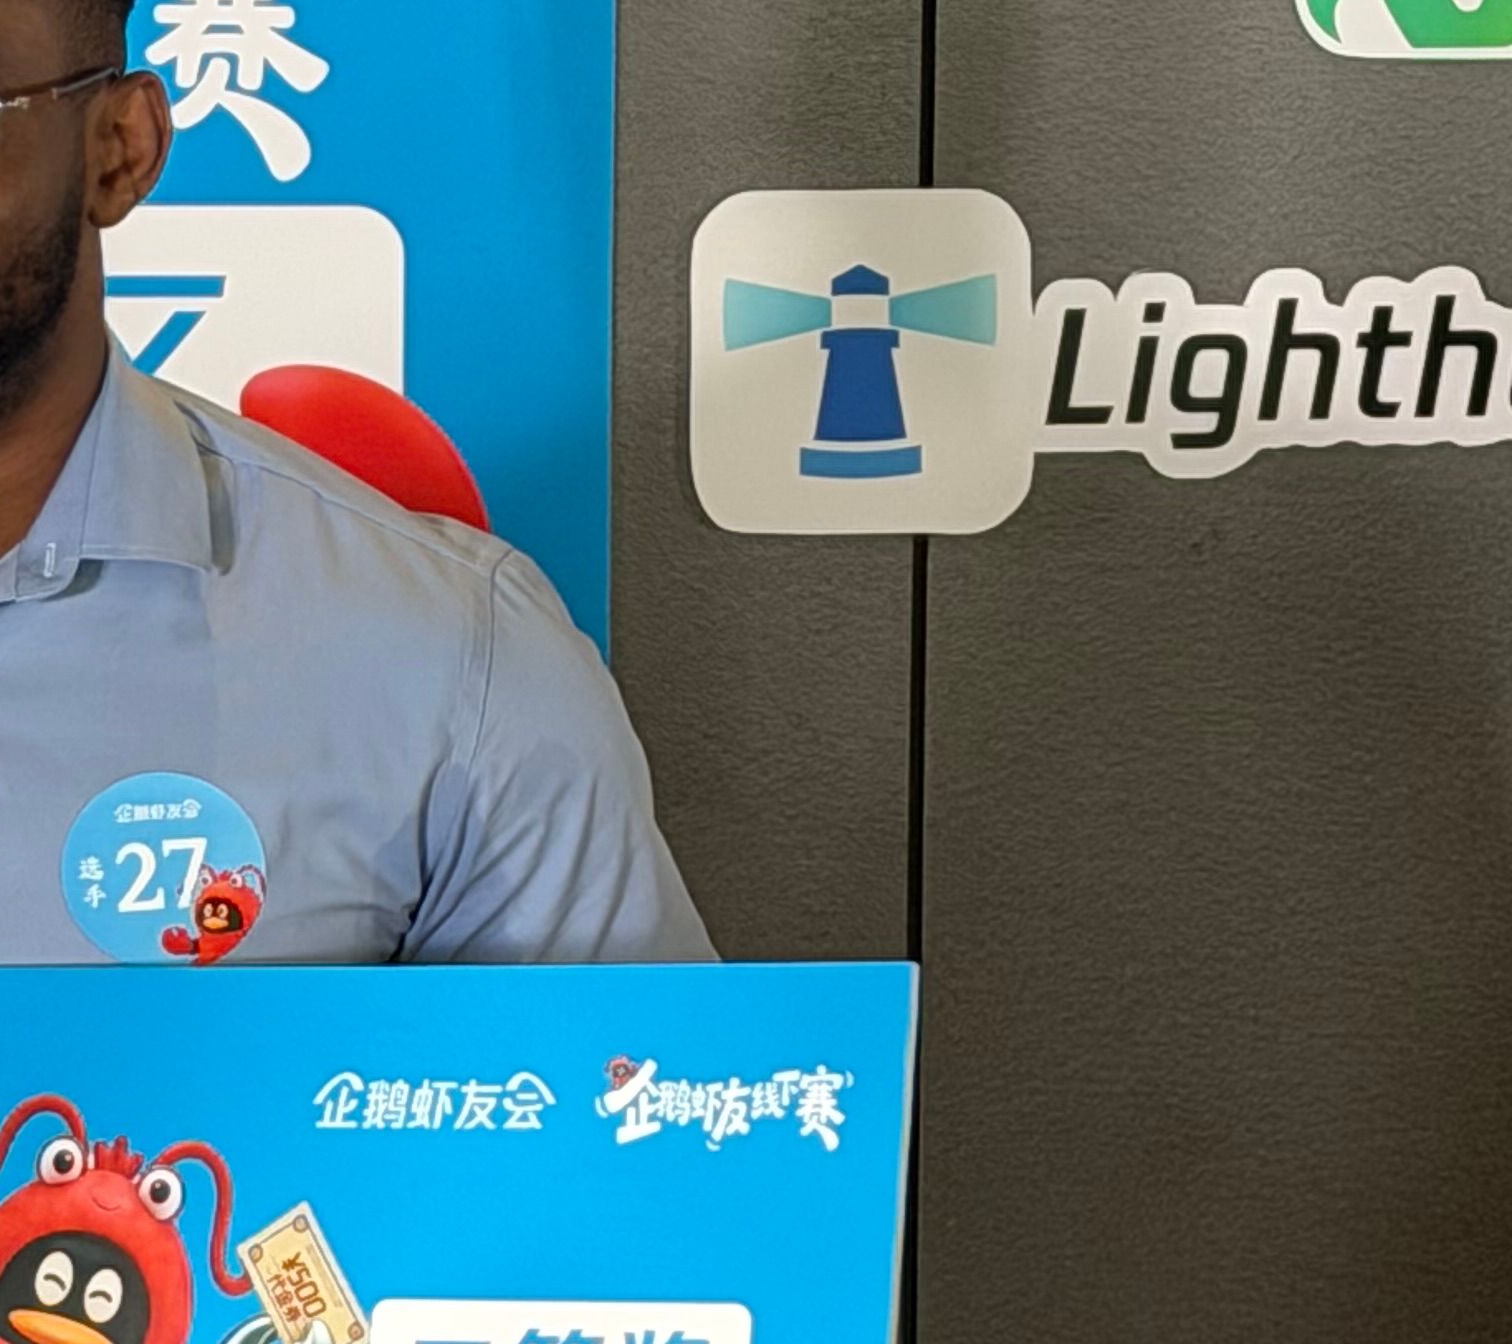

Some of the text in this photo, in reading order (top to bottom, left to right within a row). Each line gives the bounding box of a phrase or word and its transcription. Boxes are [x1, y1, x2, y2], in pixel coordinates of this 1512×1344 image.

[1043, 293, 1512, 450] Lighth
[115, 837, 208, 913] 27
[313, 1058, 847, 1152] 企鹅虾友会 企鹅虾友线下赛
